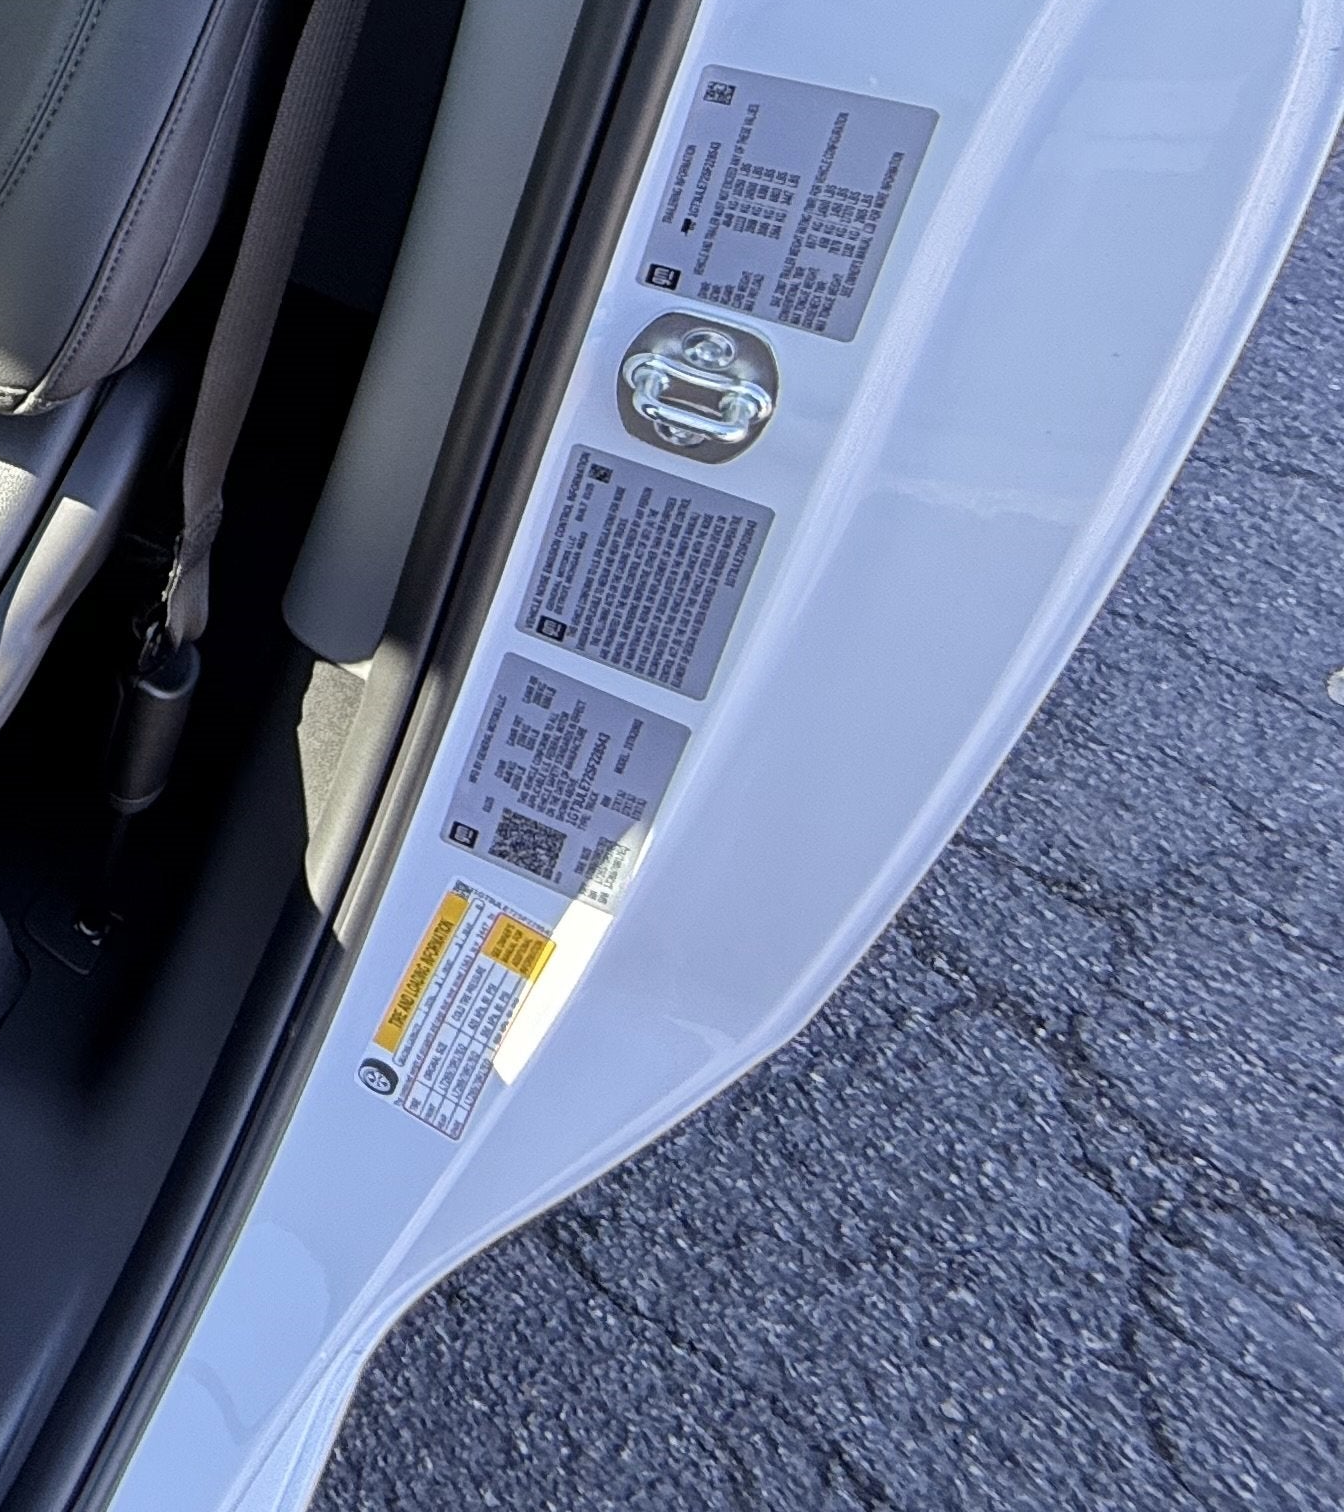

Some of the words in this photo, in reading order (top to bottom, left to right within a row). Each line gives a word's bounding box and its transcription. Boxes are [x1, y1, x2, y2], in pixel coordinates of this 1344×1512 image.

[660, 185, 684, 224] TRAILERING
[673, 142, 698, 188] INFORMATION
[565, 449, 591, 503] INFORMATION
[553, 501, 574, 539] CONTROL
[541, 536, 562, 575] EMISSION
[534, 572, 551, 598] NOISE
[523, 595, 543, 631] VEHICLE
[563, 730, 612, 827] 1GT3ULE72SF228543
[583, 789, 600, 813] TRUCK
[418, 916, 455, 967] INFORMATION
[402, 961, 431, 999] LOADING
[449, 1003, 467, 1023] COLD
[464, 963, 487, 996] PRESSURE
[386, 1006, 408, 1030] TIRE
[394, 991, 416, 1014] AND
